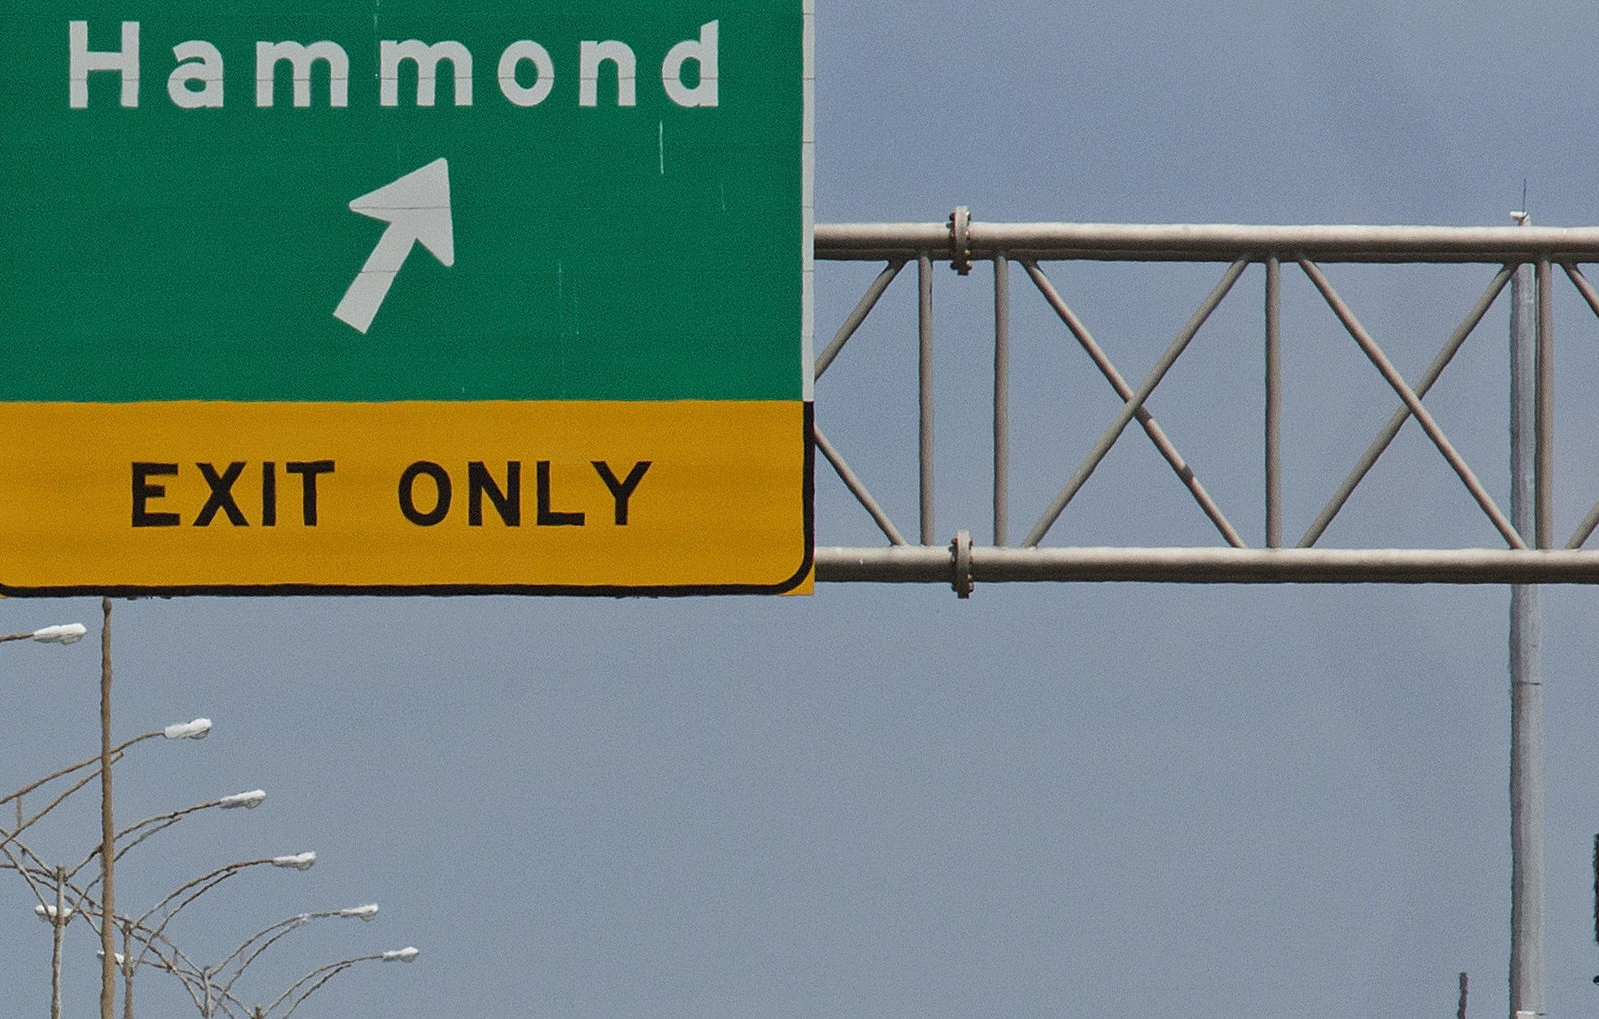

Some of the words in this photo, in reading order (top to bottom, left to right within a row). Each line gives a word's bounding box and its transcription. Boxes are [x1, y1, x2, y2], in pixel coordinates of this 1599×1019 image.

[69, 20, 719, 109] Hammond
[132, 460, 335, 528] EXIT
[398, 460, 653, 528] ONLY
